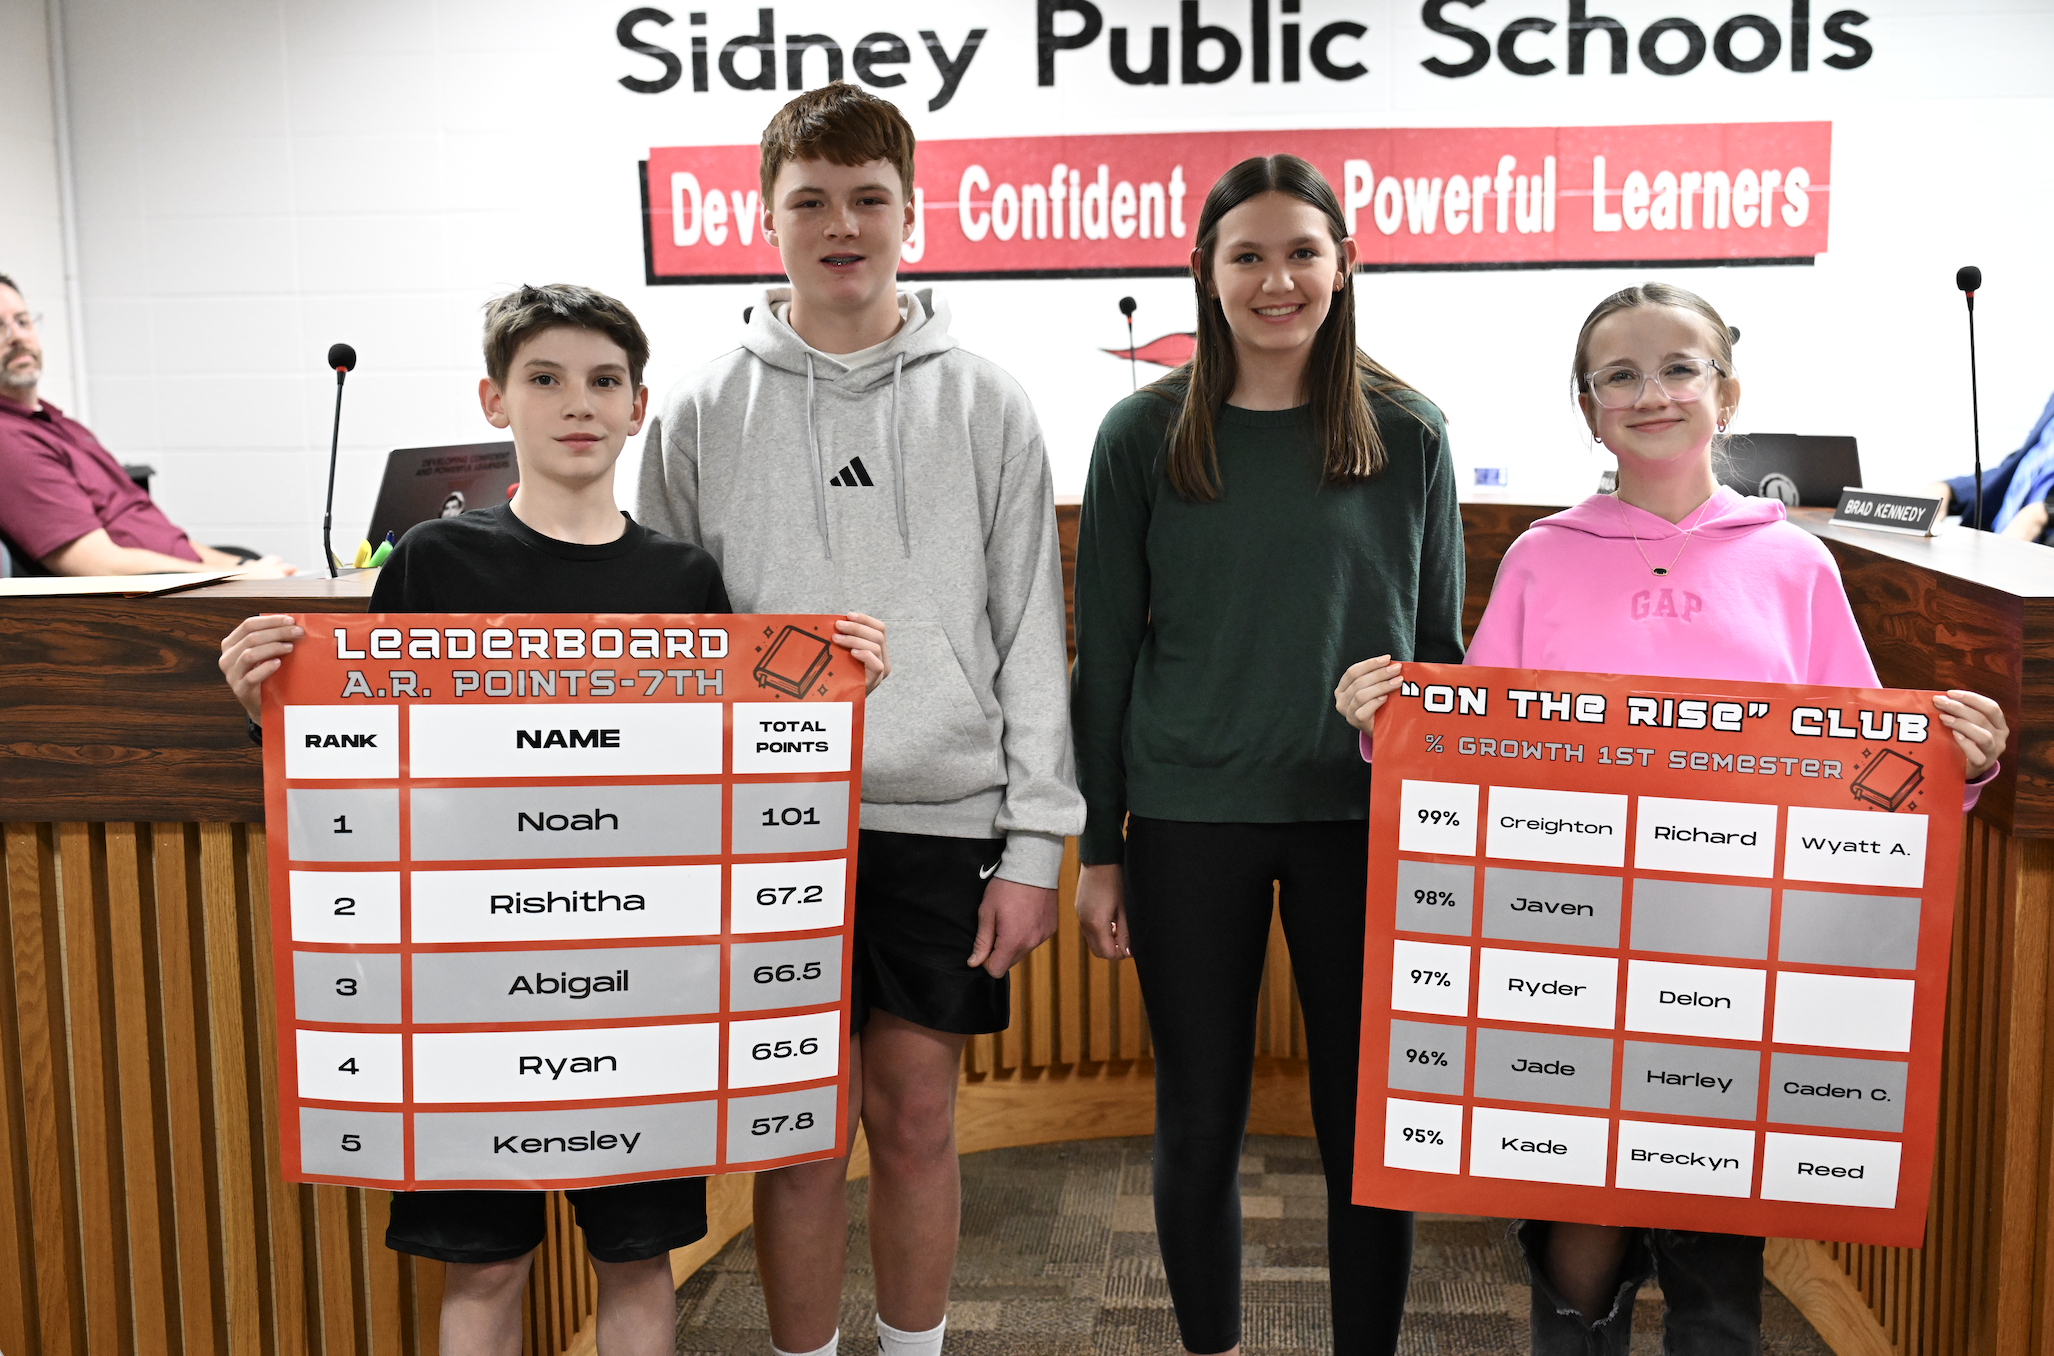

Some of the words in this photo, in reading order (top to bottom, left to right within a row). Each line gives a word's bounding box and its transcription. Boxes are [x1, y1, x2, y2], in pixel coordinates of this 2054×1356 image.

[617, 8, 987, 112] Sidney
[1037, 0, 1368, 86] Public
[1421, 0, 1872, 78] Schools
[959, 163, 1187, 242] Confident
[1344, 155, 1556, 237] Powerful
[1593, 155, 1811, 233] Learners
[1844, 499, 1873, 517] BRAD
[1873, 503, 1926, 522] KENNEDY
[1630, 588, 1702, 622] GAP
[341, 670, 432, 697] A.R.
[452, 669, 723, 697] POINTS-7TH
[759, 720, 827, 733] TOTAL
[1790, 706, 1930, 743] CLUB
[305, 734, 378, 748] RANK
[516, 729, 620, 749] NAME
[756, 741, 829, 753] POINTS
[1425, 734, 1444, 753] %
[1458, 736, 1584, 763] GROWTH
[1598, 746, 1655, 767] 1ST
[333, 815, 353, 834] 1
[518, 808, 618, 832] Noah
[762, 807, 821, 827] 101
[1417, 809, 1460, 827] 99%
[1500, 816, 1613, 835] Creighton
[1654, 825, 1757, 846] Richard
[1801, 837, 1881, 855] Wyatt
[1889, 843, 1911, 856] A.
[490, 889, 645, 915] Rishitha
[756, 885, 823, 906] 67.2
[1414, 889, 1456, 907] 98%
[334, 897, 356, 916] 2
[1510, 897, 1594, 917] Javen
[753, 961, 822, 984] 66.5
[1410, 969, 1451, 987] 97%
[335, 978, 358, 997] 3
[508, 969, 629, 1000] Abigail
[1508, 978, 1587, 997] Ryder
[1659, 990, 1731, 1009] Delon
[752, 1037, 818, 1061] 65.6
[1406, 1048, 1448, 1067] 96%
[338, 1057, 360, 1075] 4
[519, 1055, 617, 1081] Ryan
[1511, 1058, 1576, 1076] Jade
[1646, 1070, 1733, 1094] Harley
[1783, 1081, 1862, 1100] Caden
[1870, 1088, 1891, 1102] C.
[751, 1111, 815, 1136] 57.8
[341, 1134, 362, 1152] 5
[494, 1130, 641, 1154] Kensley
[1402, 1127, 1444, 1146] 95%
[1501, 1137, 1568, 1155] Kade
[1631, 1148, 1739, 1171] Breckyn
[1797, 1162, 1864, 1179] Reed
